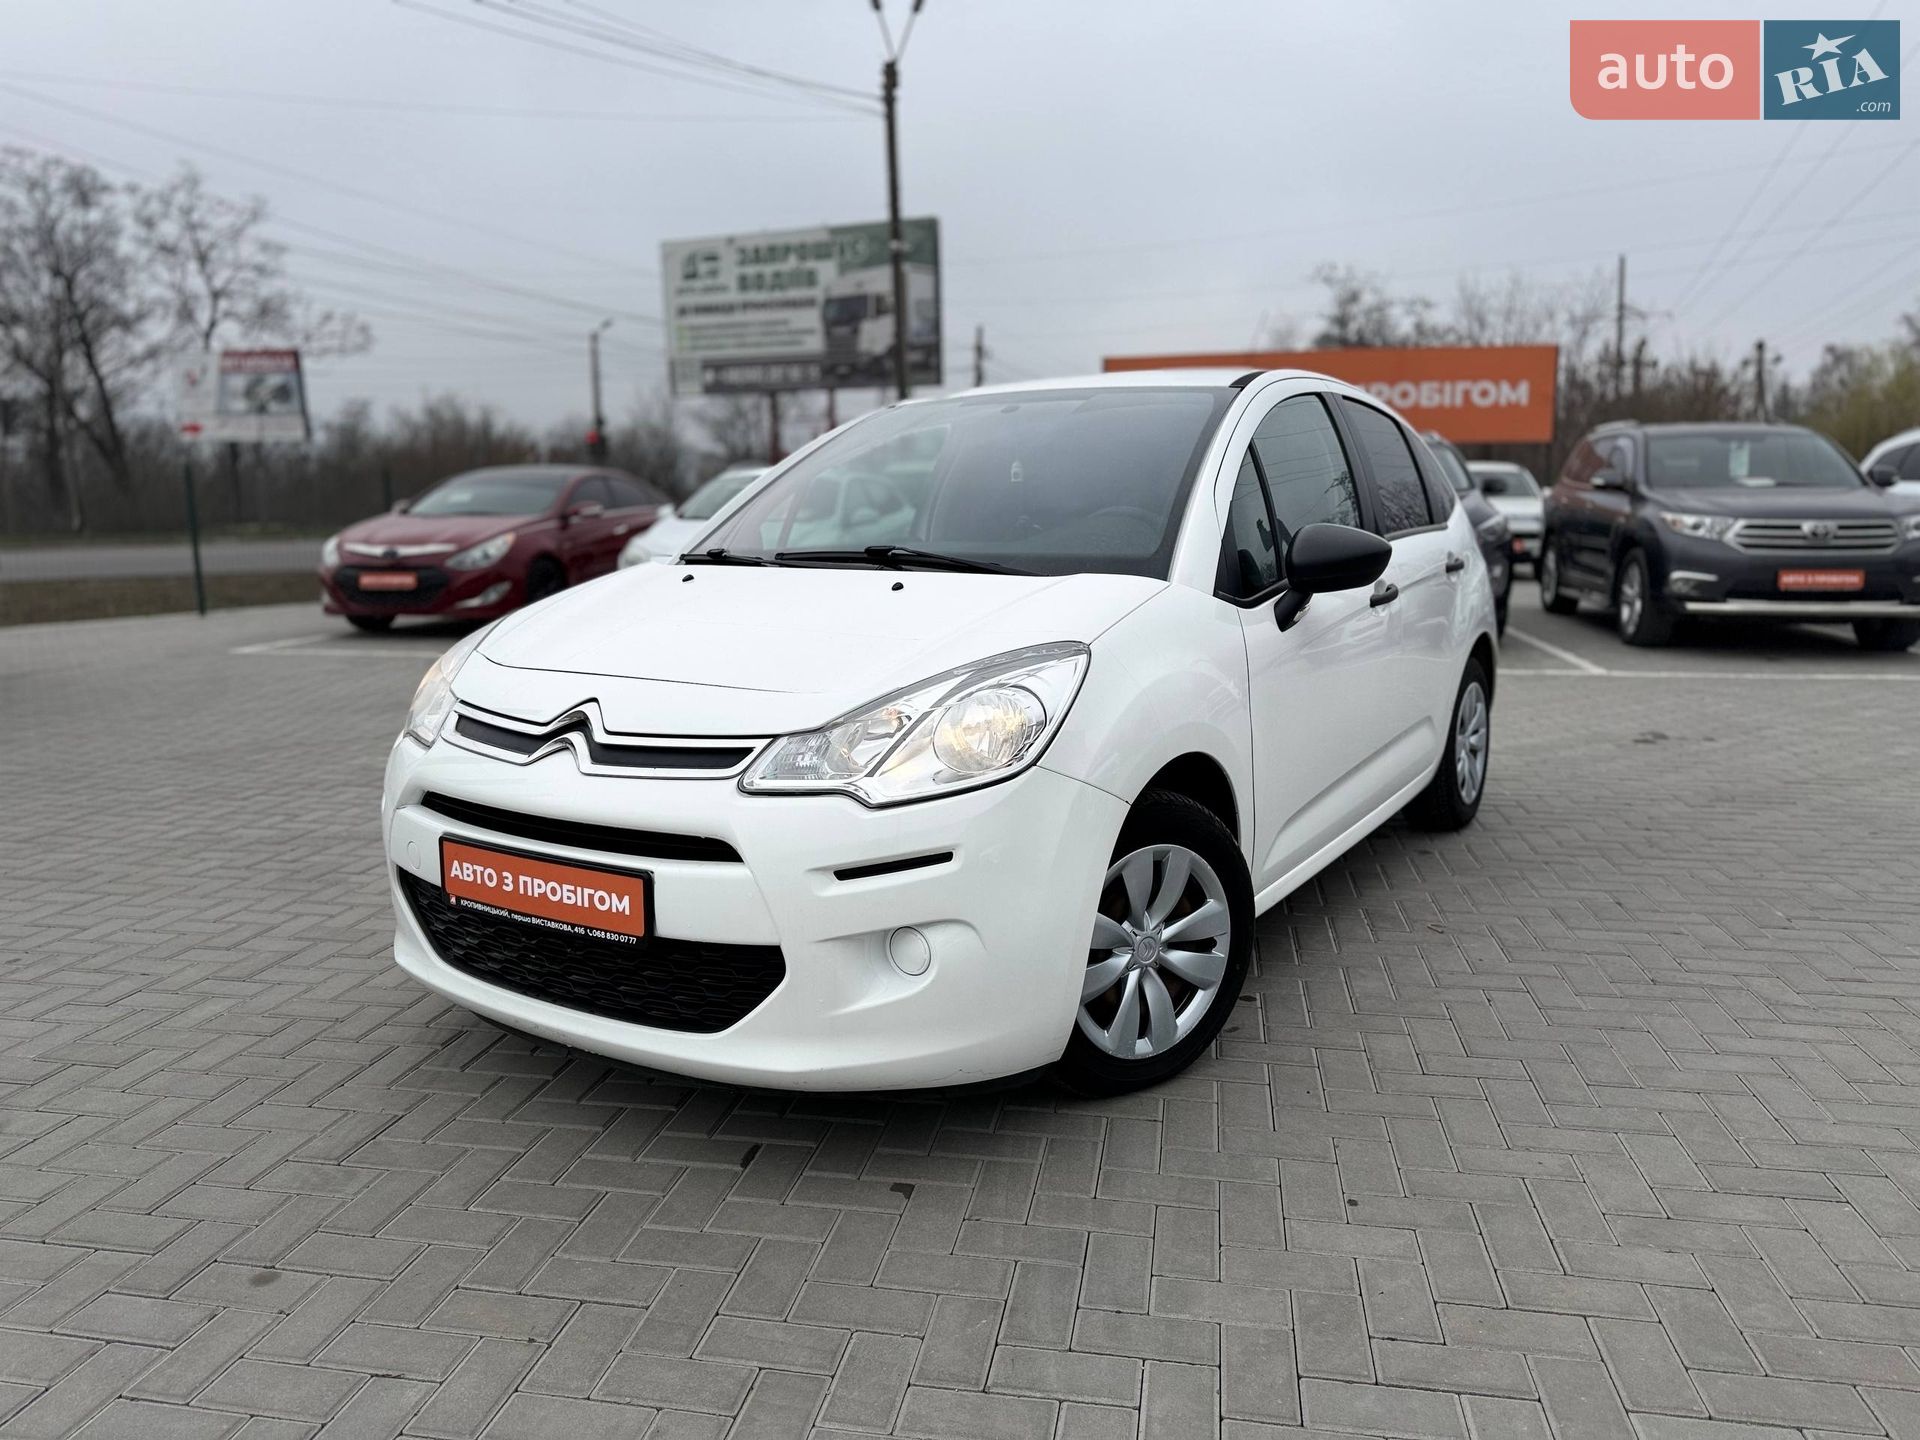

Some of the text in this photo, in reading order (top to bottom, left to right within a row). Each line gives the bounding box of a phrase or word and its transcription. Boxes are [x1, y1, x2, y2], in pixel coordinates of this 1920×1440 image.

[1354, 379, 1530, 408] РОБІГОМ
[450, 859, 630, 916] АВТО З ПРОБІГОМ
[531, 917, 574, 934] ВИСТАВКОВА,
[574, 926, 585, 935] 416
[592, 930, 606, 939] 068
[606, 932, 619, 942] 830
